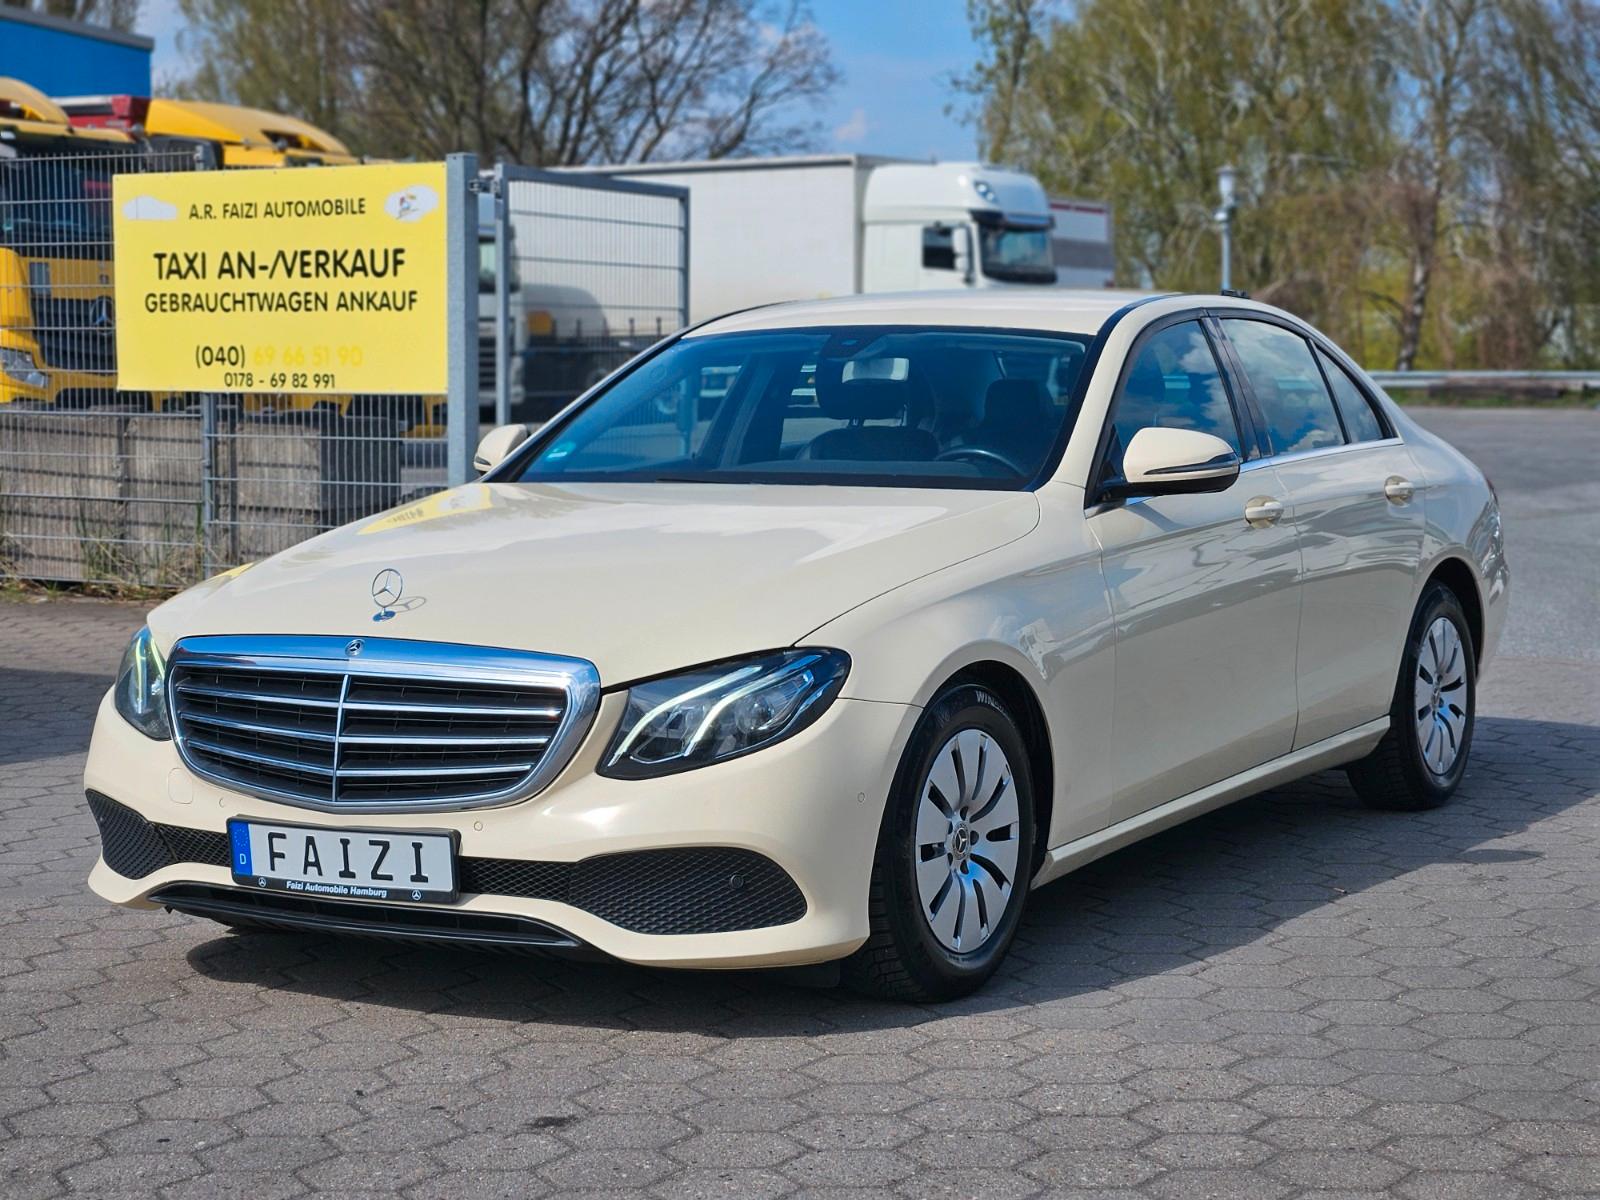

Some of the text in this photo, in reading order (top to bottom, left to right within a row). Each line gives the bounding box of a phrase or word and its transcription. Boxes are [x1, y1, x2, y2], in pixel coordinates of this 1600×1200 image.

[188, 197, 366, 220] A.R. FAIZI AUTOMOBILE
[153, 251, 207, 281] TAXI
[144, 290, 418, 314] GEBRAUCHTWAGEN ANKAUF
[195, 345, 246, 369] (040)
[253, 345, 275, 366] 69
[282, 345, 305, 366] 66
[337, 345, 363, 367] 90
[223, 371, 254, 388] 0178
[269, 372, 288, 389] 69
[291, 372, 308, 389] 82
[313, 373, 335, 389] 991
[239, 853, 247, 865] D
[286, 880, 387, 898] Faizi Automobile Hamburg
